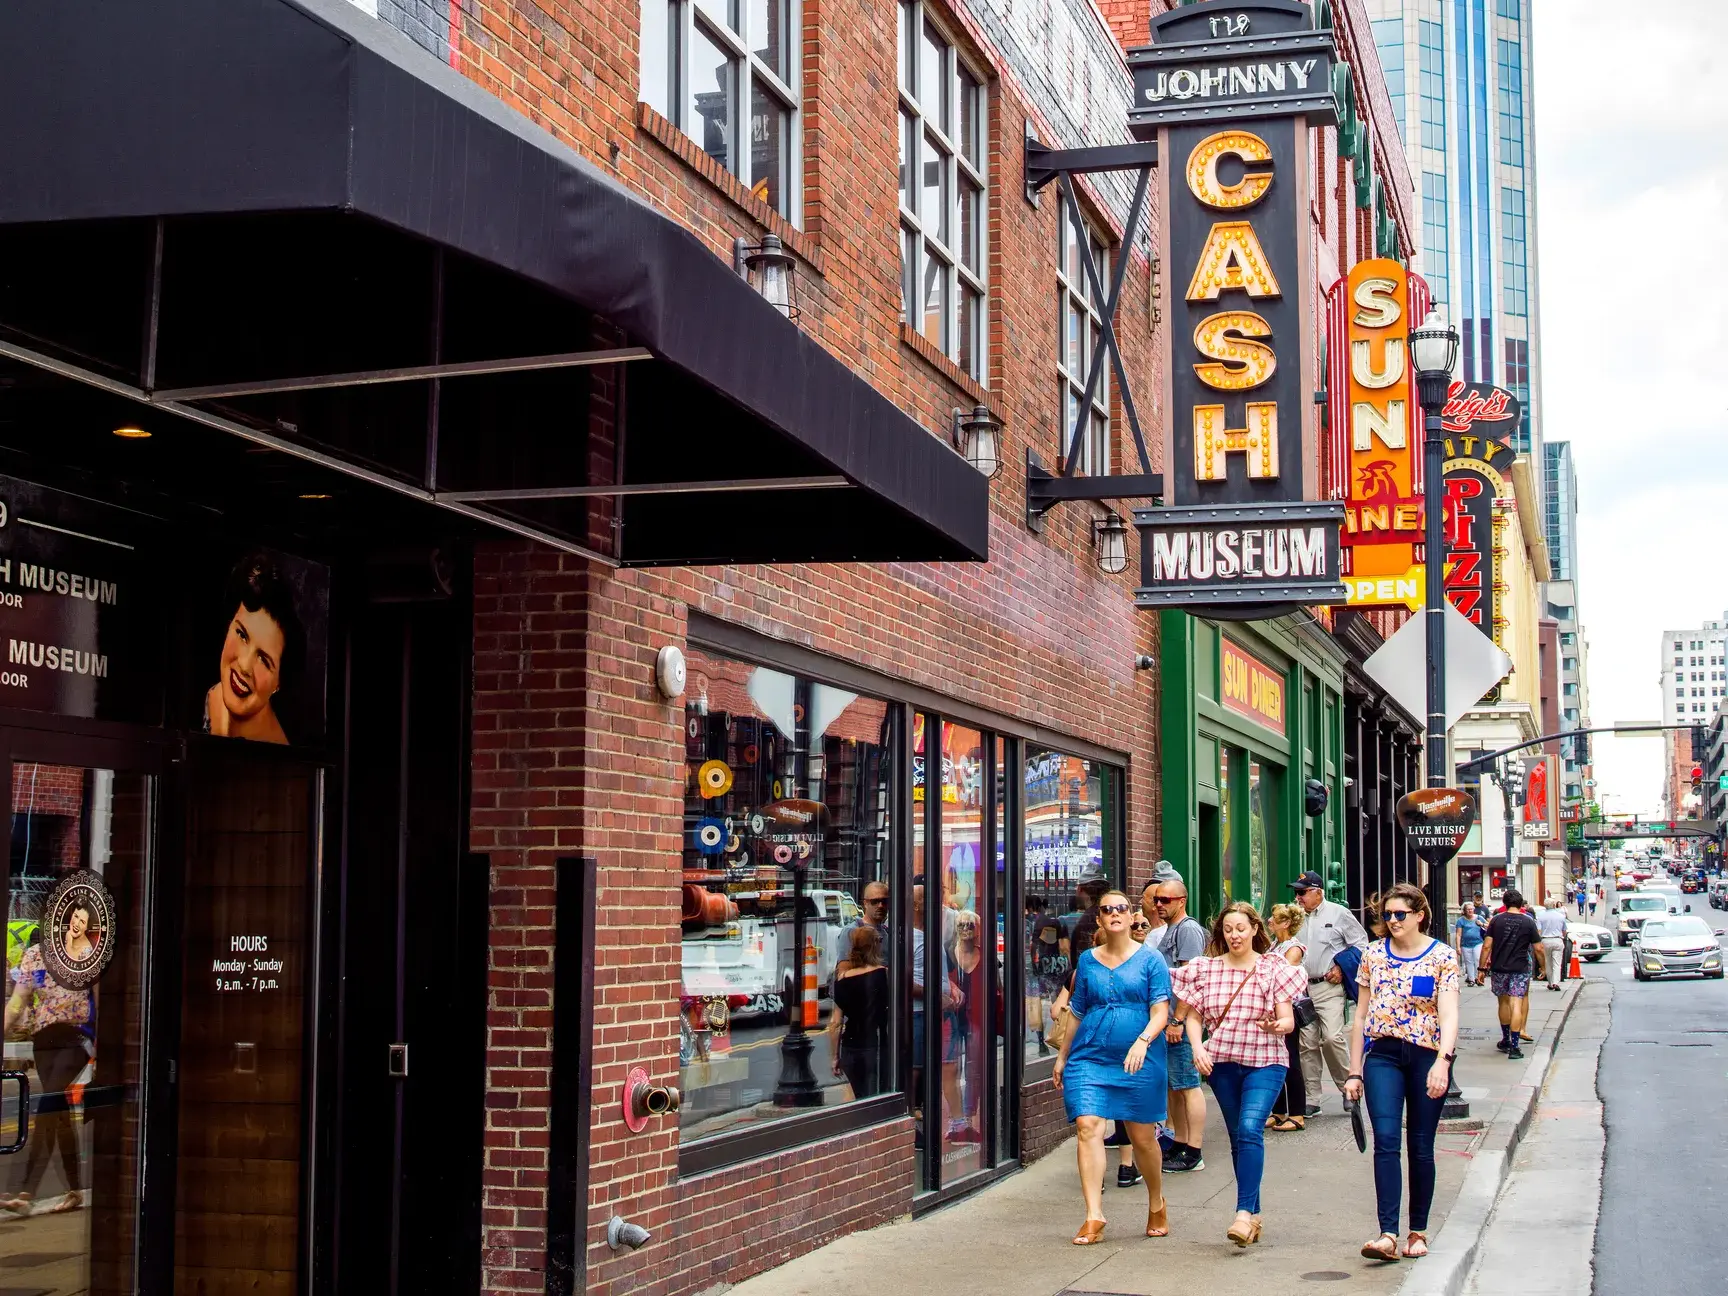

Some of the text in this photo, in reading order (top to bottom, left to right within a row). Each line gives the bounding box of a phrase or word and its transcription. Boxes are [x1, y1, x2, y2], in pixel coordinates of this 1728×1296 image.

[1145, 59, 1318, 102] JOHNNY
[1184, 129, 1282, 482] CASH
[1352, 277, 1406, 451] SUN
[1444, 436, 1503, 462] ITY
[1340, 503, 1449, 533] INE
[1153, 527, 1326, 580] MUSEUM
[1443, 477, 1483, 625] PIZZ
[20, 562, 117, 606] MUSEUM
[9, 638, 108, 678] MUSEUM
[0, 671, 28, 689] OOR
[1224, 650, 1282, 724] SUN DINER
[1408, 825, 1465, 835] LIVE MUSIC
[1417, 837, 1456, 846] VENUES
[1524, 829, 1549, 837] RED
[69, 888, 88, 898] CLINE
[231, 936, 268, 952] HOURS
[212, 959, 246, 974] Monday
[253, 958, 284, 973] Sunday
[1041, 955, 1069, 975] CAS
[216, 978, 222, 991] 9
[223, 980, 244, 991] a.m.
[252, 977, 258, 990] 7
[260, 979, 279, 992] p.m.
